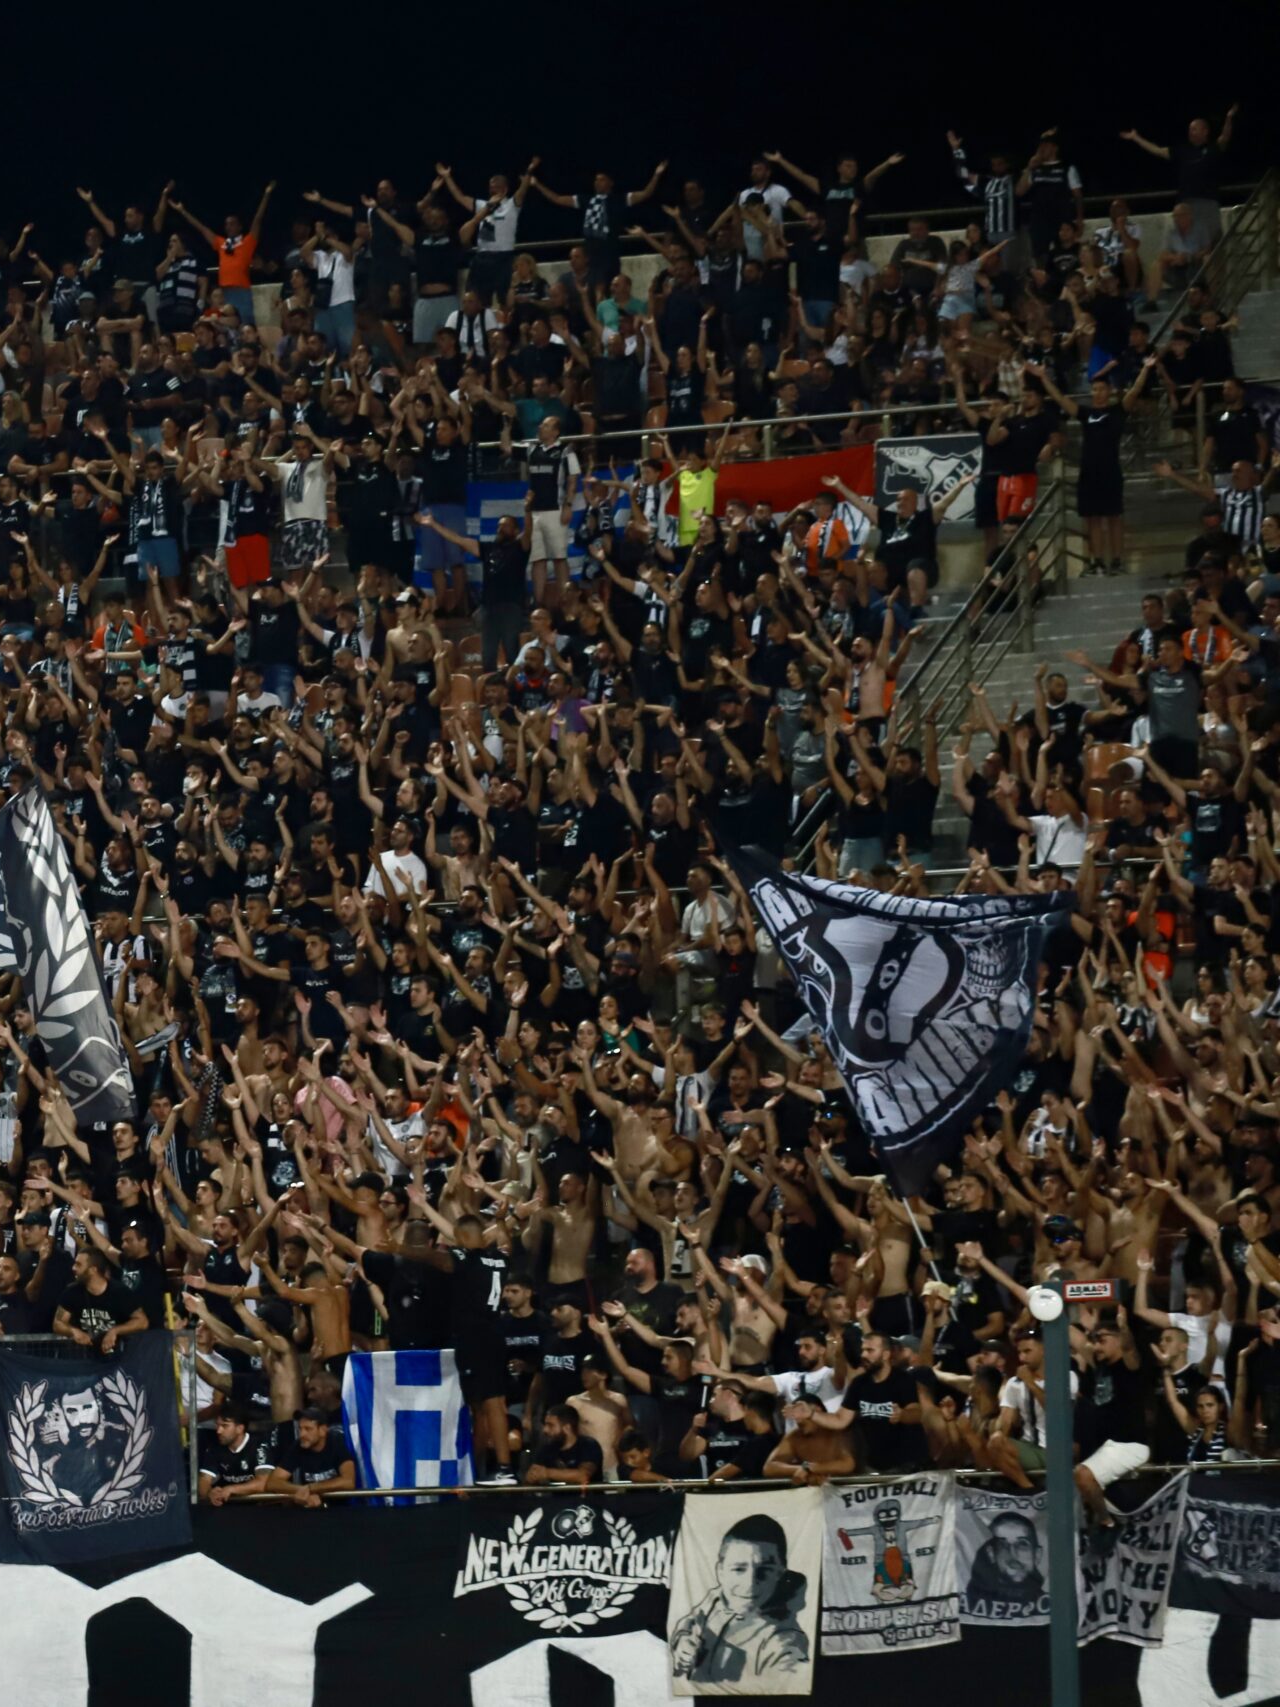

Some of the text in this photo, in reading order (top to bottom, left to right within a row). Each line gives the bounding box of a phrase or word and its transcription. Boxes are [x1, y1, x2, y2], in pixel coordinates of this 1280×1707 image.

[841, 1480, 939, 1508] FOOTBALL
[462, 1533, 673, 1586] NEW GENERATION
[840, 1555, 868, 1566] BEER
[915, 1546, 937, 1557] SEX
